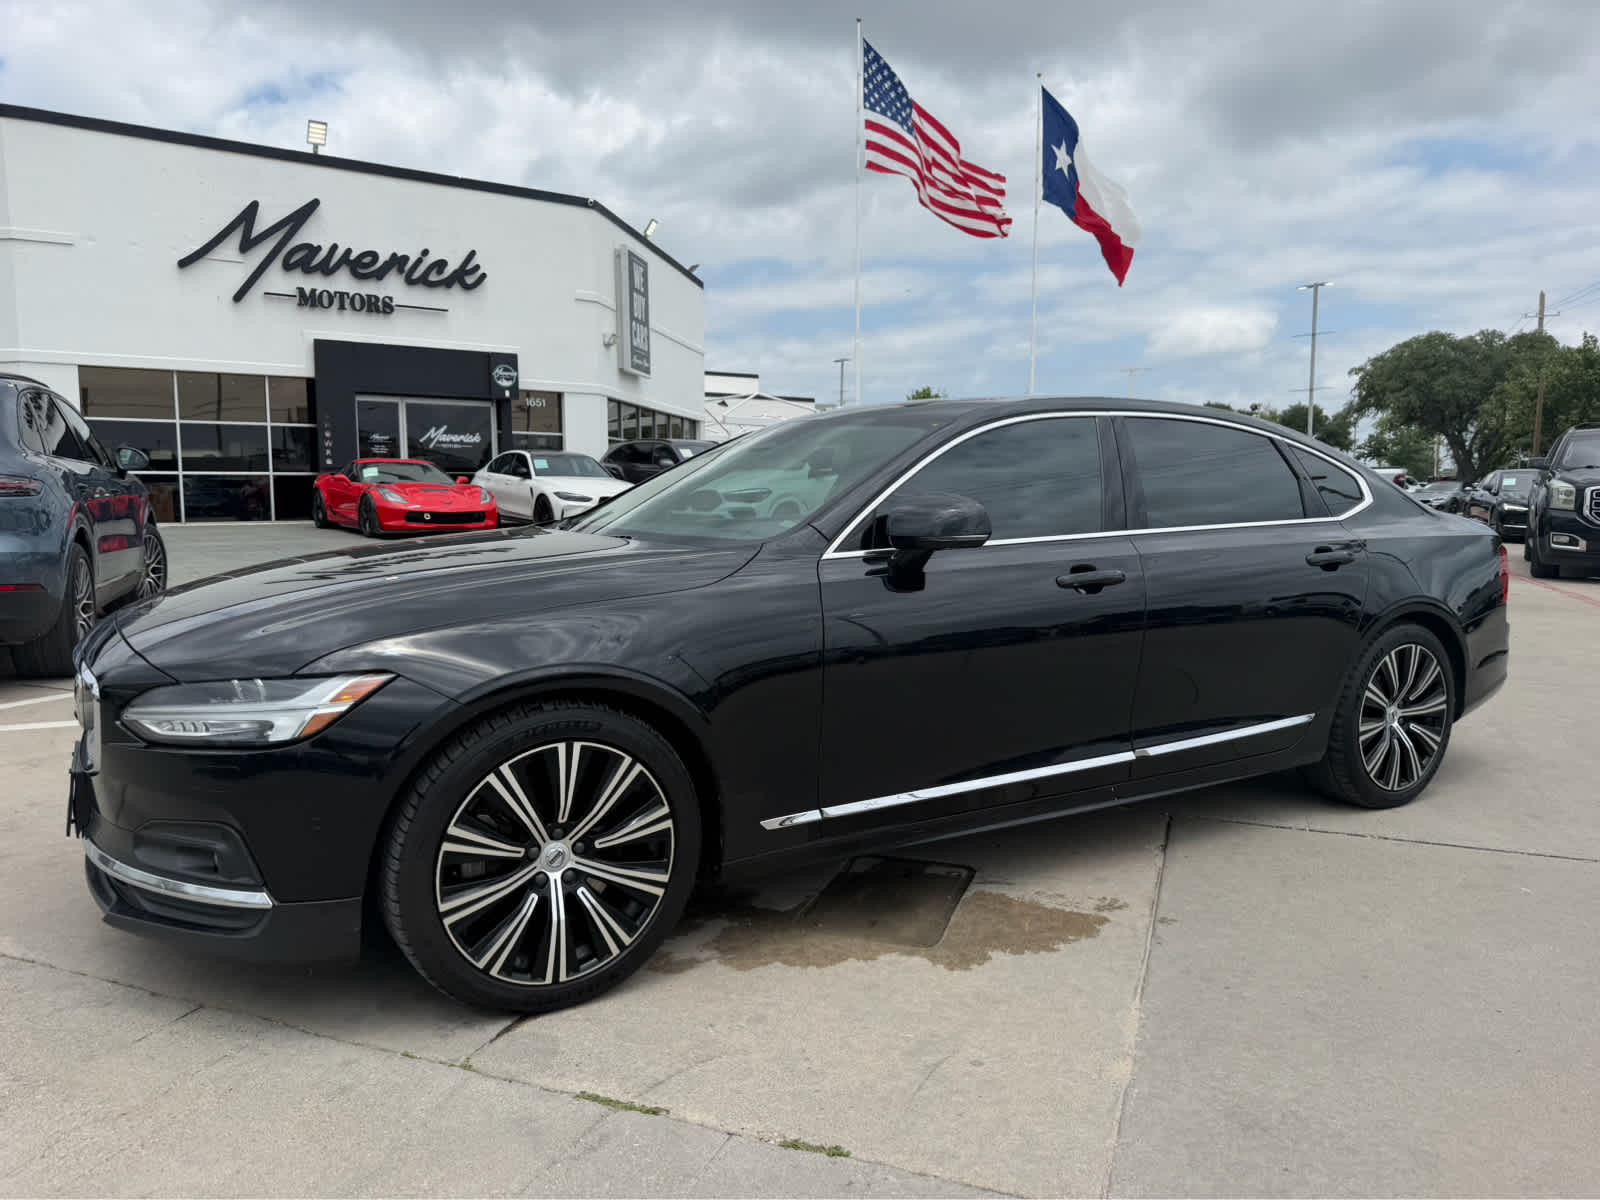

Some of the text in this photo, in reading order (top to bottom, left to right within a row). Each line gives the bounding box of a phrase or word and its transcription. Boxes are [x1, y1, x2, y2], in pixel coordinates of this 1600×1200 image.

[177, 197, 487, 303] Maverick
[296, 287, 394, 315] MOTORS
[526, 397, 546, 408] 1651
[419, 424, 482, 449] Maverick
